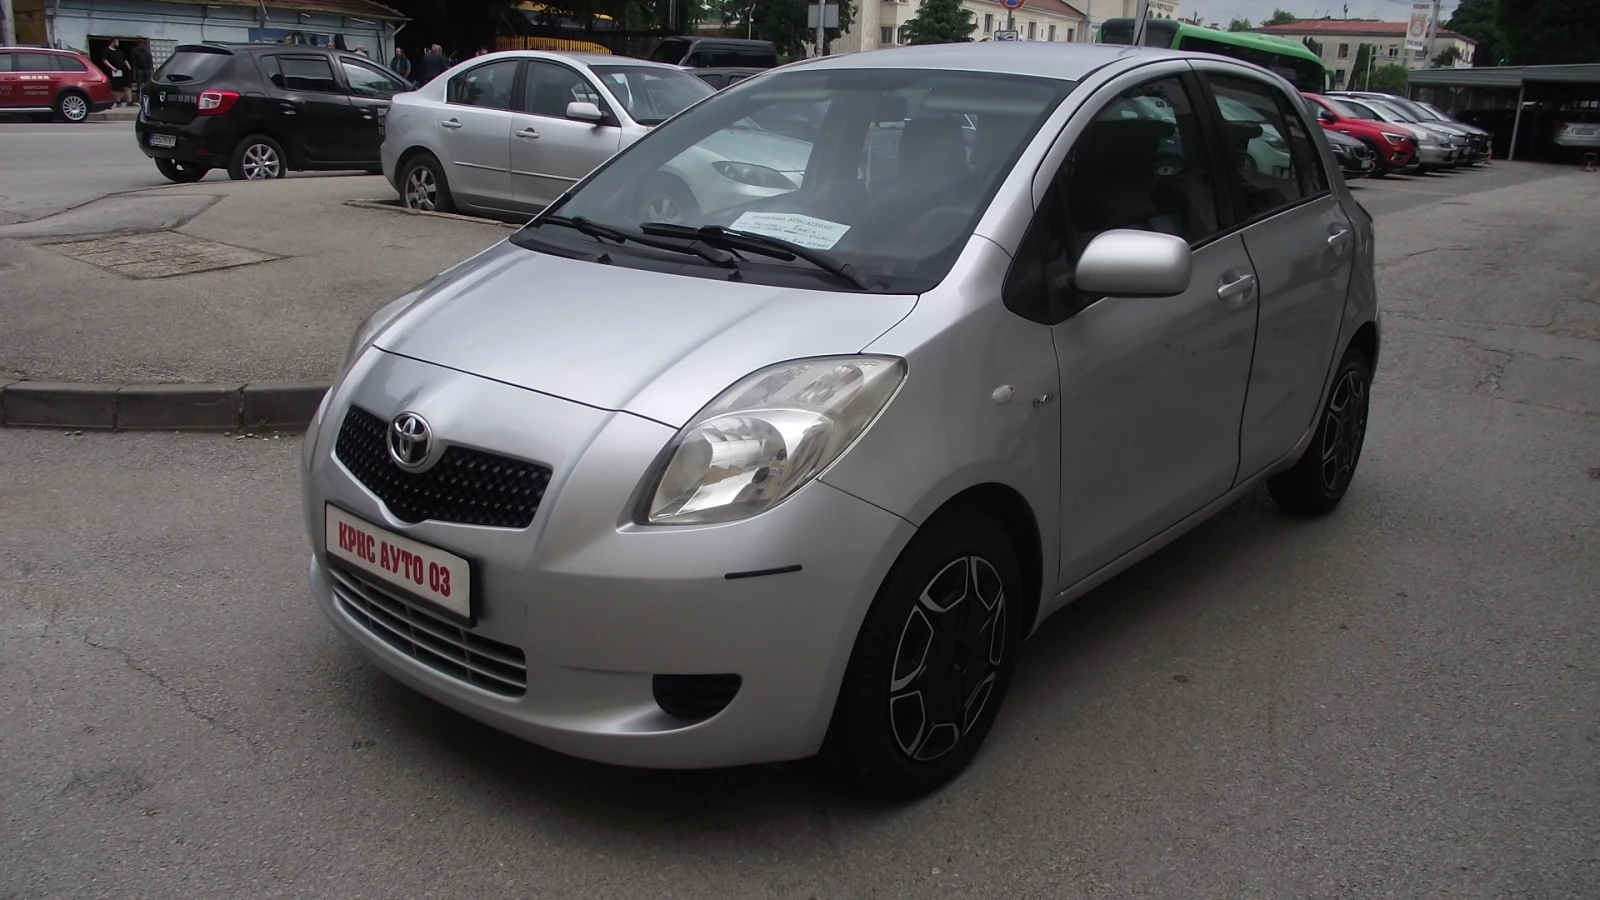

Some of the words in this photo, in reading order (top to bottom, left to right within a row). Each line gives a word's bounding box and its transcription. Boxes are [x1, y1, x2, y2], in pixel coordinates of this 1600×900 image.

[338, 521, 376, 564] КРИС
[380, 541, 424, 585] АУТО
[429, 561, 451, 597] 03
